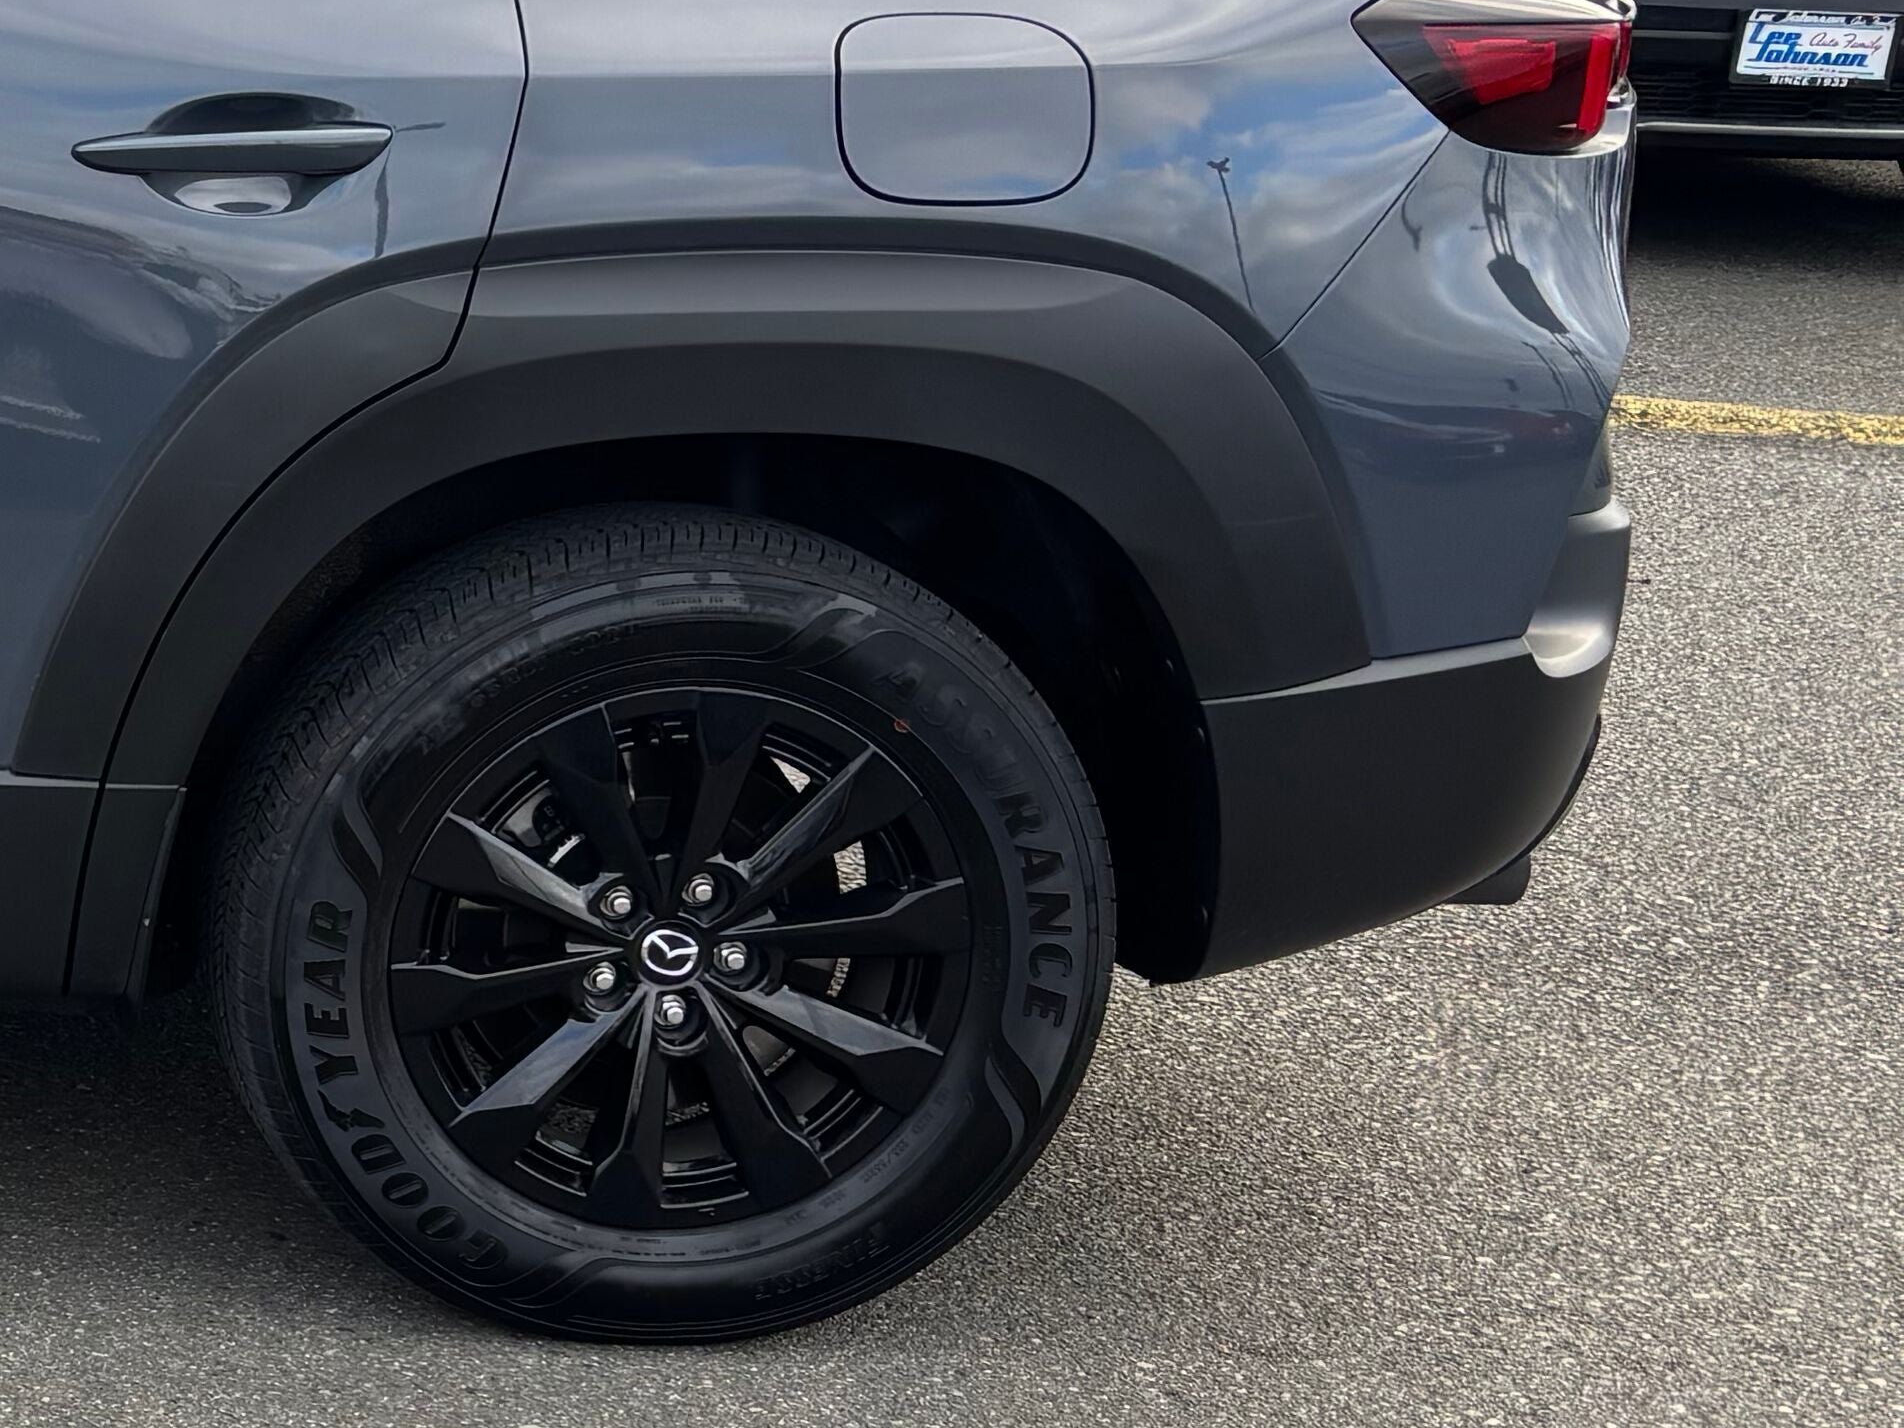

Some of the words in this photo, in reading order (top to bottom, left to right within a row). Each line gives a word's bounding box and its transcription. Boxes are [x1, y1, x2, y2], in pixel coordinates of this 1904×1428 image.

[1748, 22, 1803, 46] Lee
[1809, 32, 1840, 47] Auto
[1746, 43, 1869, 68] Johnson
[874, 661, 1074, 1027] ASSURANCE
